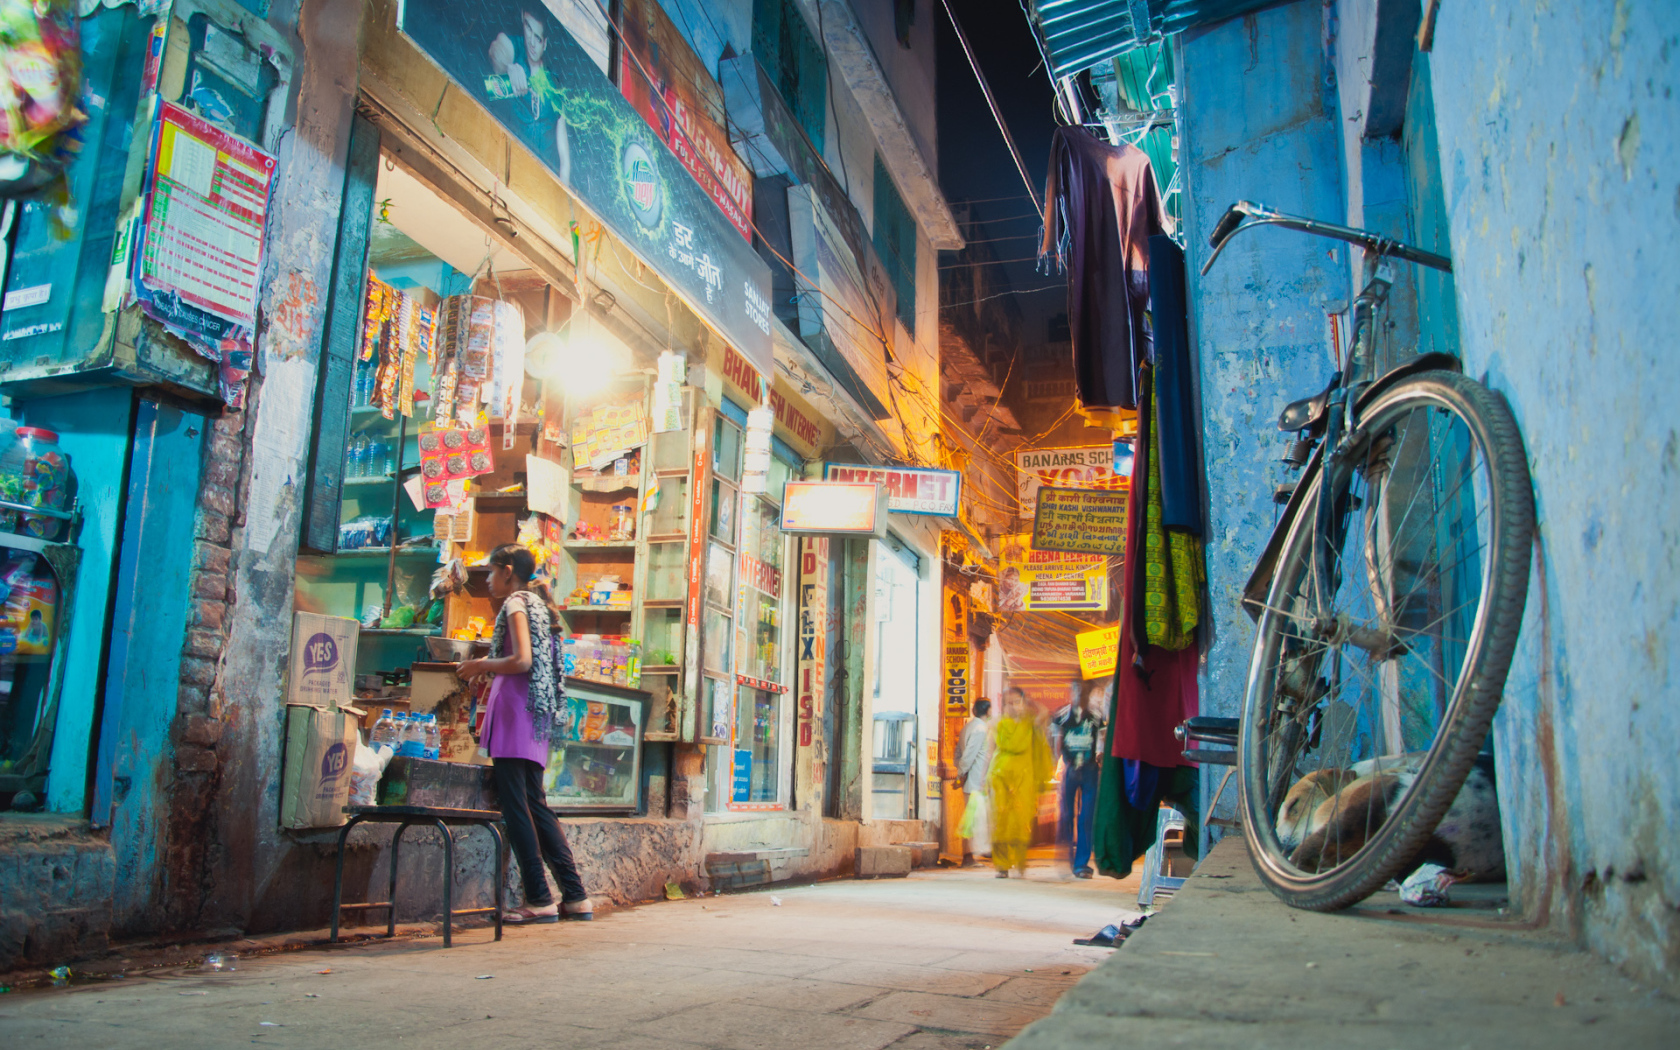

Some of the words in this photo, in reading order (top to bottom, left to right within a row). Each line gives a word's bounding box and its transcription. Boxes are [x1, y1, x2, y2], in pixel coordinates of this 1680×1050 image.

[675, 138, 697, 173] FULL
[698, 167, 720, 198] FULL
[719, 194, 748, 234] MASALA
[672, 221, 693, 250] डर
[678, 251, 694, 270] आगे
[695, 253, 722, 291] जीत
[744, 281, 770, 318] SANJAY
[745, 300, 770, 336] STORES
[723, 347, 786, 422] BHAVSH
[1023, 452, 1085, 468] BANARAS
[1089, 451, 1113, 465] SCH
[831, 467, 952, 502] INTERNET
[1059, 504, 1078, 512] KASHI
[1082, 505, 1125, 513] VISHWANATH
[1028, 551, 1060, 563] HEENA
[309, 641, 333, 664] YES
[946, 656, 967, 664] SCHOOL
[947, 669, 966, 704] YOGA
[328, 750, 346, 773] YES
